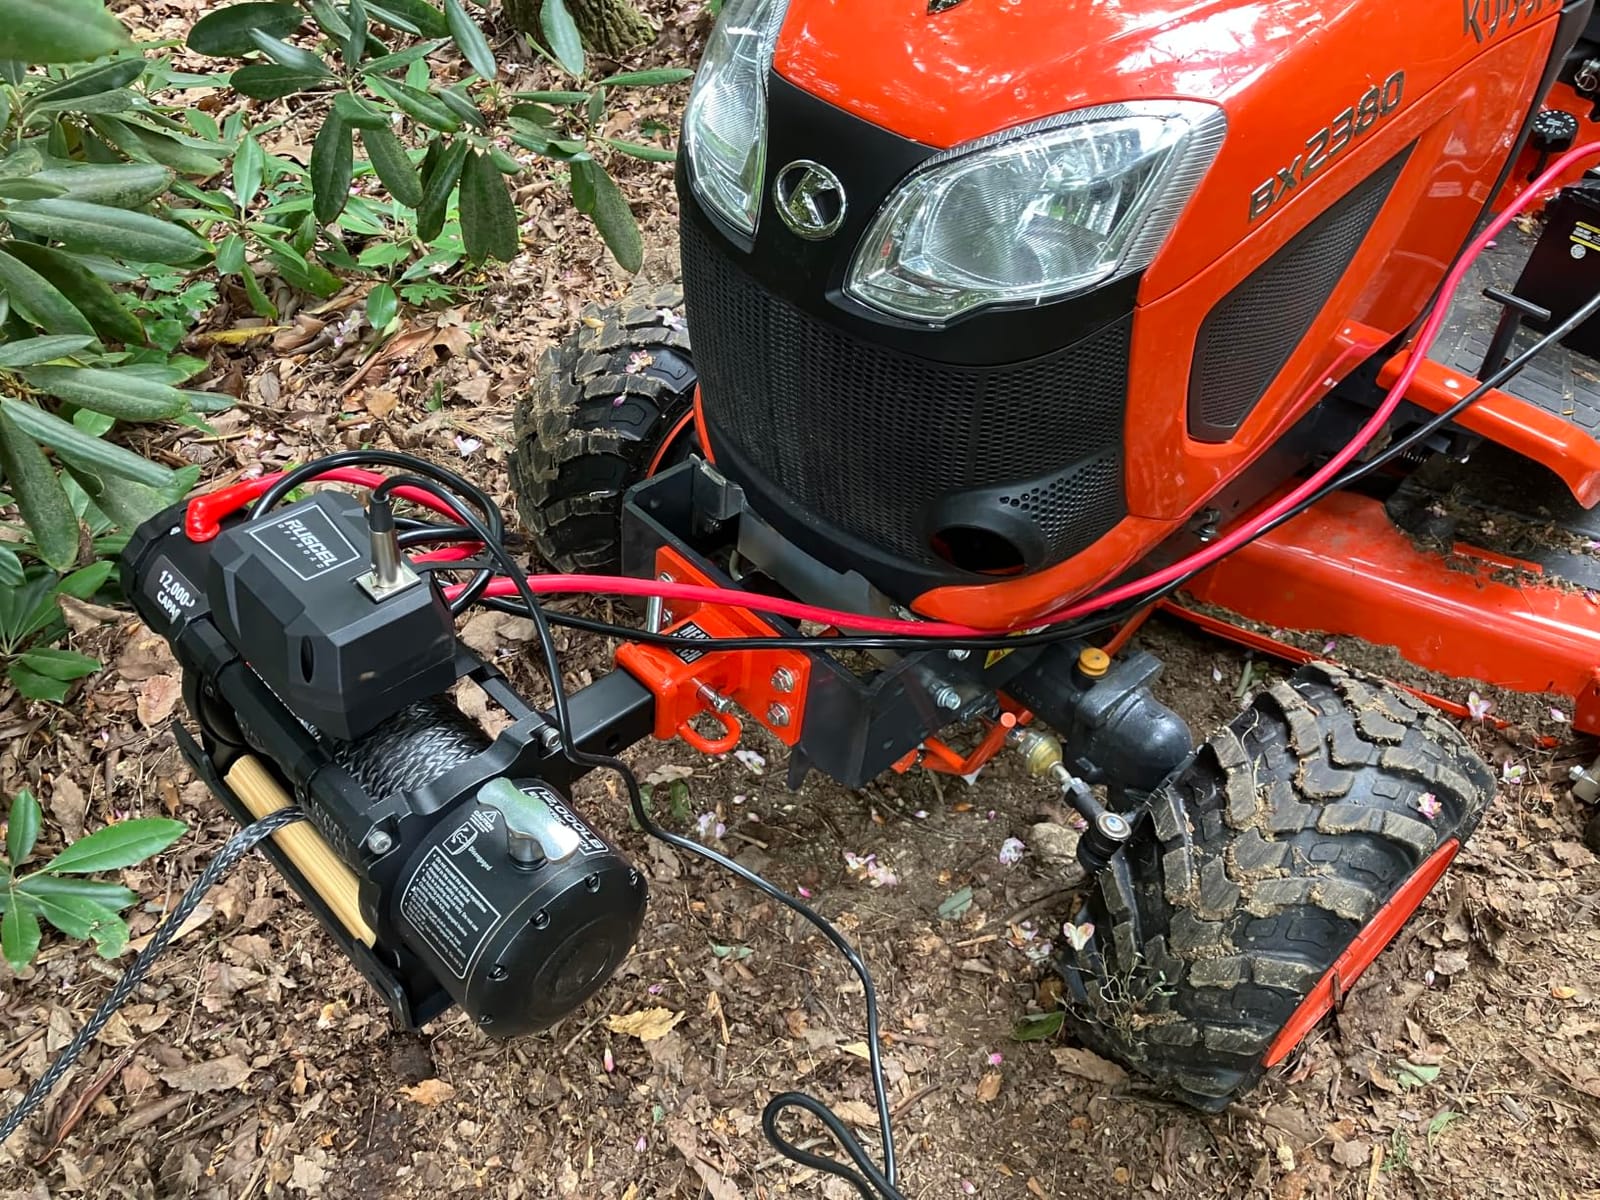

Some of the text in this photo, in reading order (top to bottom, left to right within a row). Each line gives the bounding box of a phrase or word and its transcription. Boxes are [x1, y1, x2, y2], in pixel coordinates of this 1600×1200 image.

[1248, 69, 1405, 223] BX2380
[284, 519, 338, 566] RUGCEL
[539, 790, 604, 849] 12,000LB
